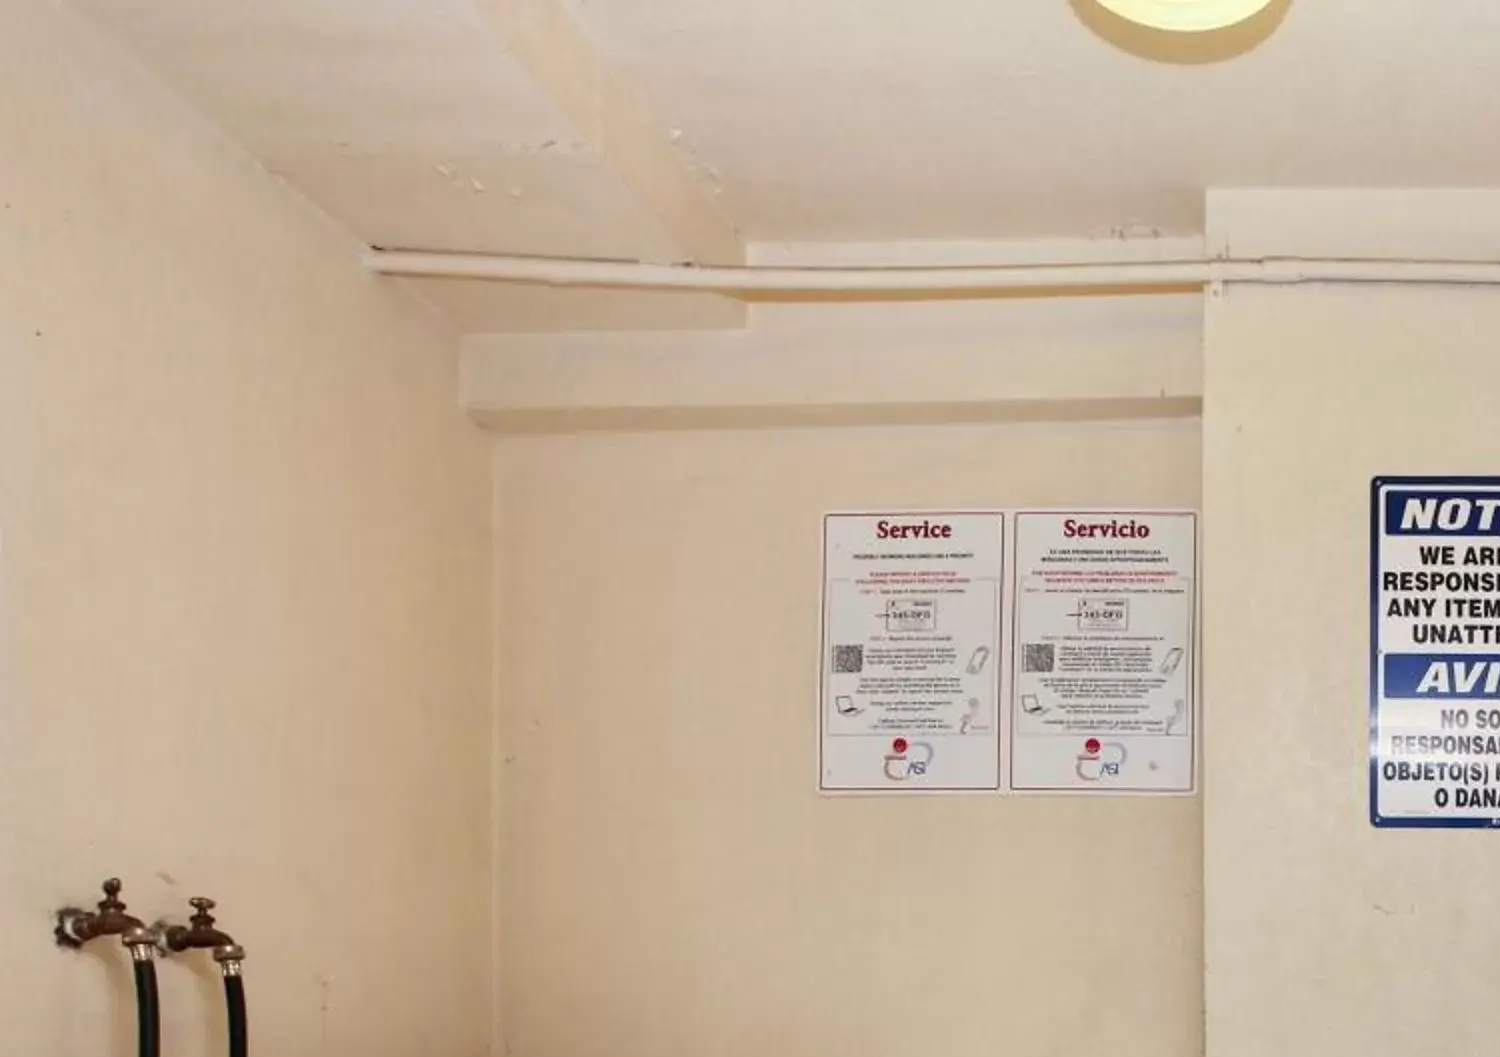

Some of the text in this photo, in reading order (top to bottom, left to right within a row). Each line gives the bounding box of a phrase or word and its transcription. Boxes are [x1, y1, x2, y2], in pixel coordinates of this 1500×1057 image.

[877, 521, 952, 539] Service
[1064, 520, 1150, 538] Servicio
[1420, 547, 1454, 565] WE
[1387, 599, 1435, 618] ANY
[1441, 710, 1469, 728] NO
[1383, 762, 1489, 785] OBJETO(S)
[1434, 788, 1449, 808] O
